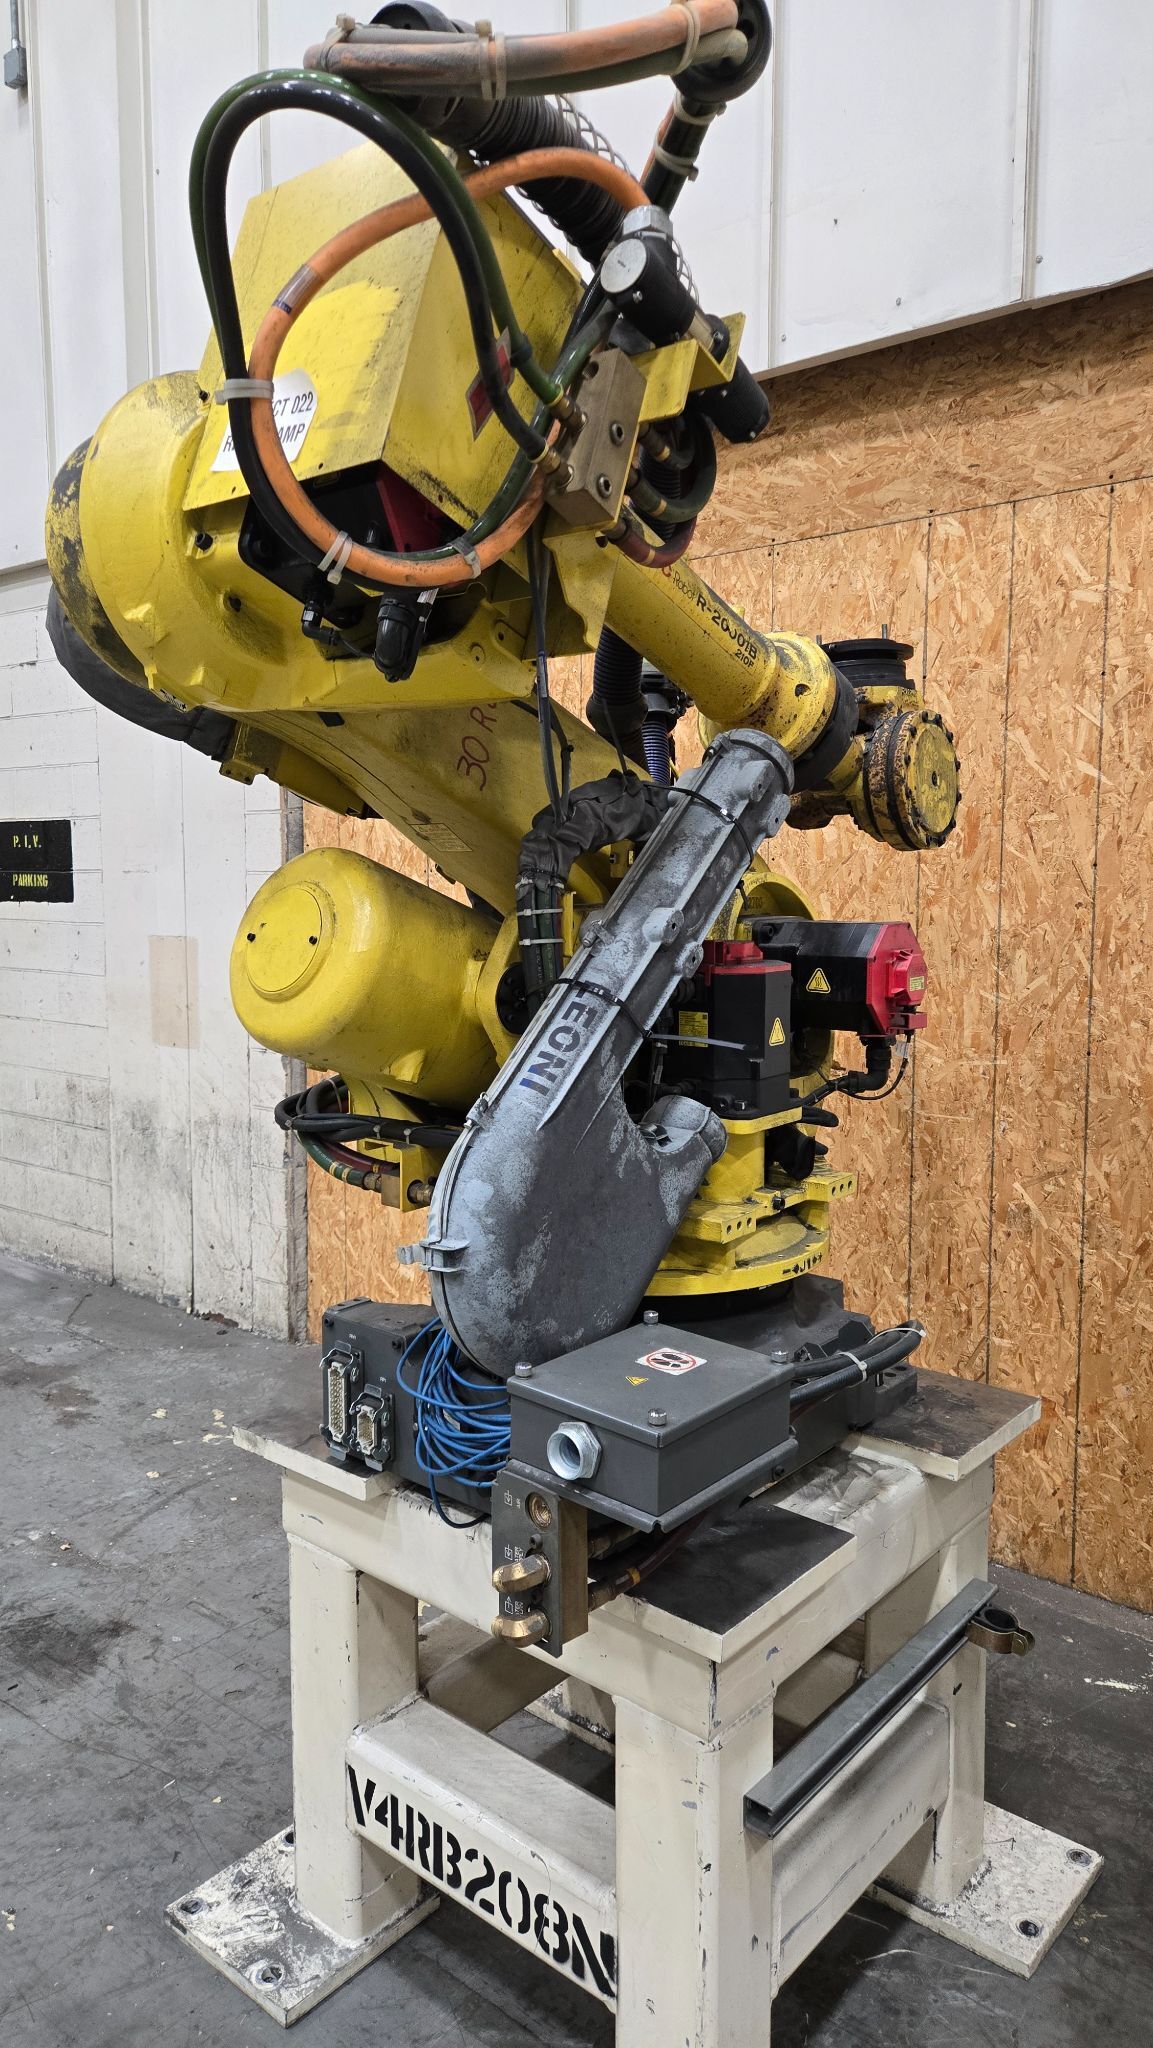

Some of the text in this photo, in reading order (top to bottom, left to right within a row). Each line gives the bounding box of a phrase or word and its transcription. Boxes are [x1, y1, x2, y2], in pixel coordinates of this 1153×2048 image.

[457, 736, 490, 791] 30
[13, 834, 42, 849] P.I.V.
[12, 873, 48, 887] PARKING
